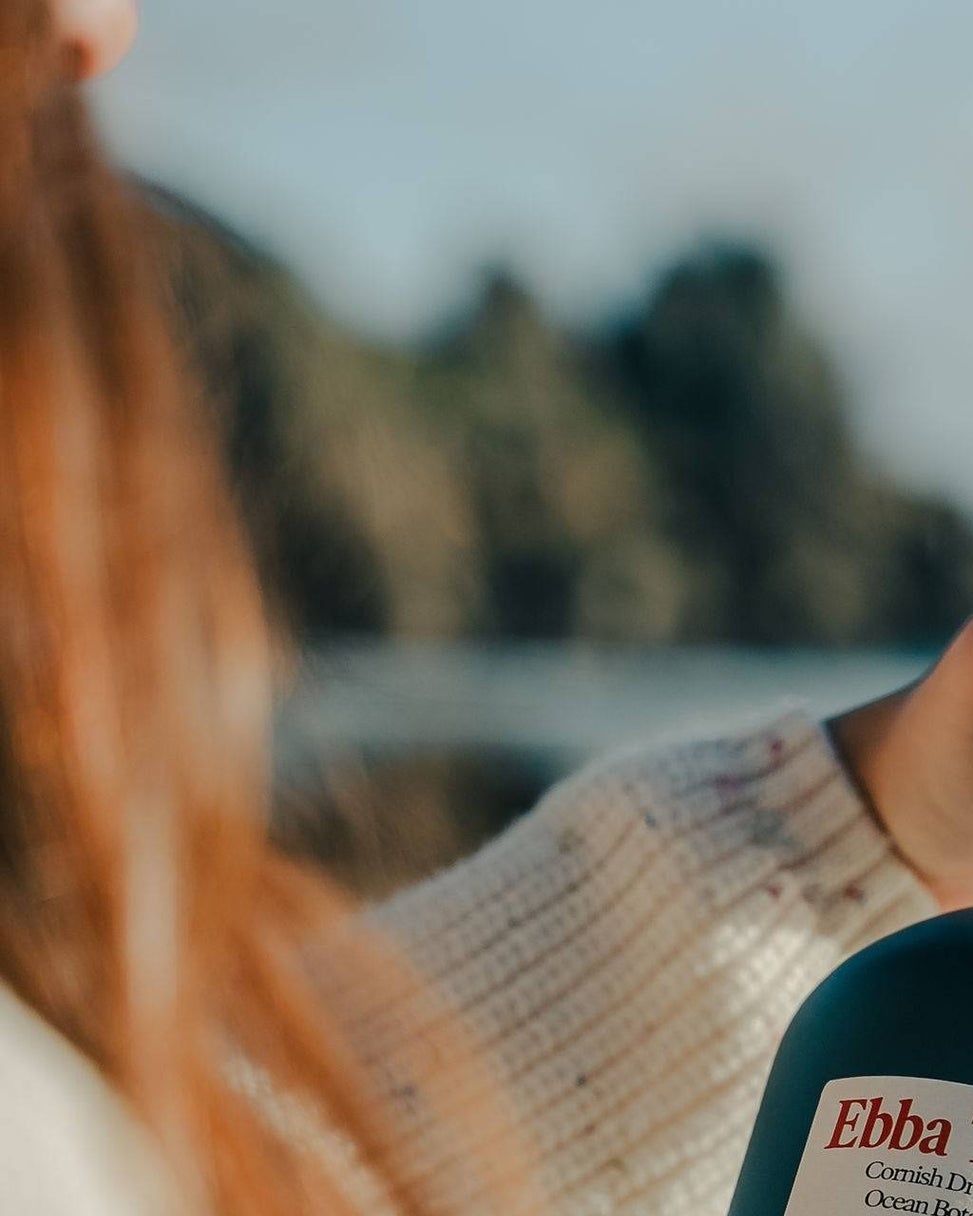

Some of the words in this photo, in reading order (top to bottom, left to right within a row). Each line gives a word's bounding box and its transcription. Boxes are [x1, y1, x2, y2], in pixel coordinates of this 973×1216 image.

[824, 1097, 953, 1157] Ebba
[865, 1161, 943, 1190] Cornish
[864, 1189, 928, 1216] Ocean
